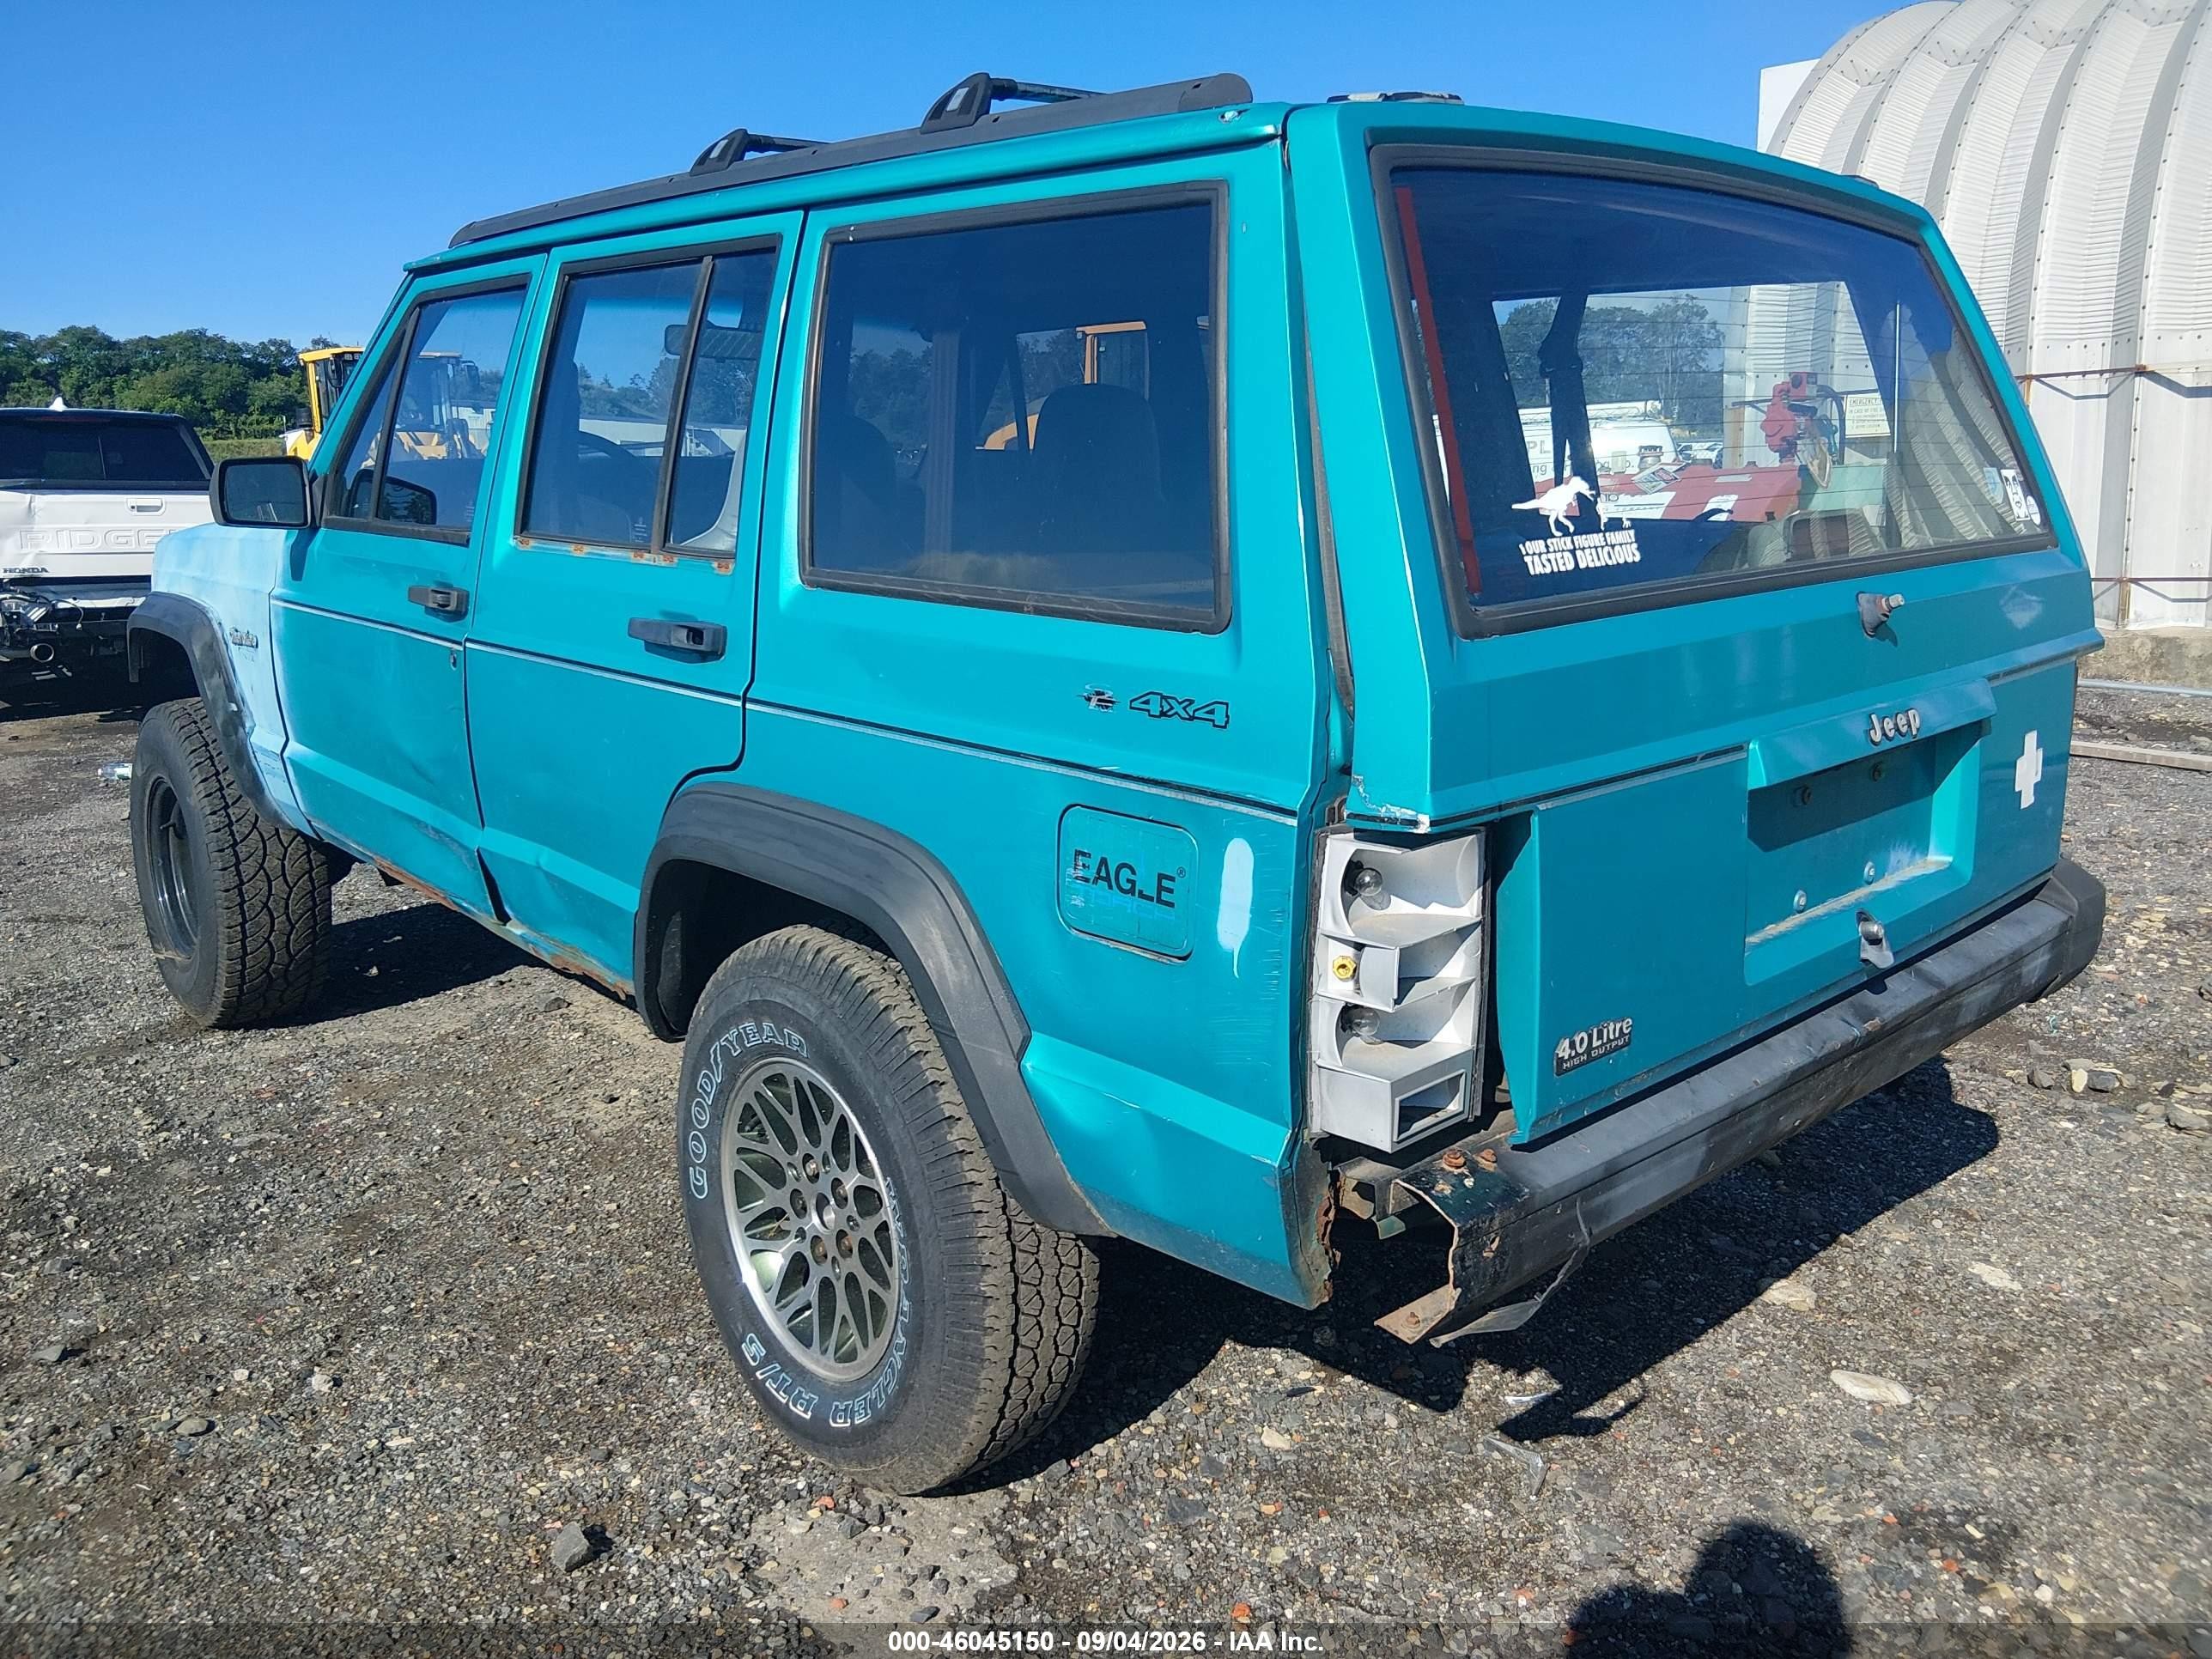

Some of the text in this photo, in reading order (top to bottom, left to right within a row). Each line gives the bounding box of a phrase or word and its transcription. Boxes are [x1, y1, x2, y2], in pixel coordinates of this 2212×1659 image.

[20, 529, 180, 550] RIDGE
[1546, 536, 1574, 551] STICK
[1573, 532, 1606, 549] FIGURE
[1605, 529, 1636, 545] FAMILY
[1524, 543, 1641, 575] TASTED DELICIOUS
[1869, 708, 1921, 744] Jeep
[1555, 1018, 1632, 1060] 4.0 Litre
[1563, 1035, 1631, 1070] HIGH OUTPUT
[741, 1333, 819, 1419] RT/S
